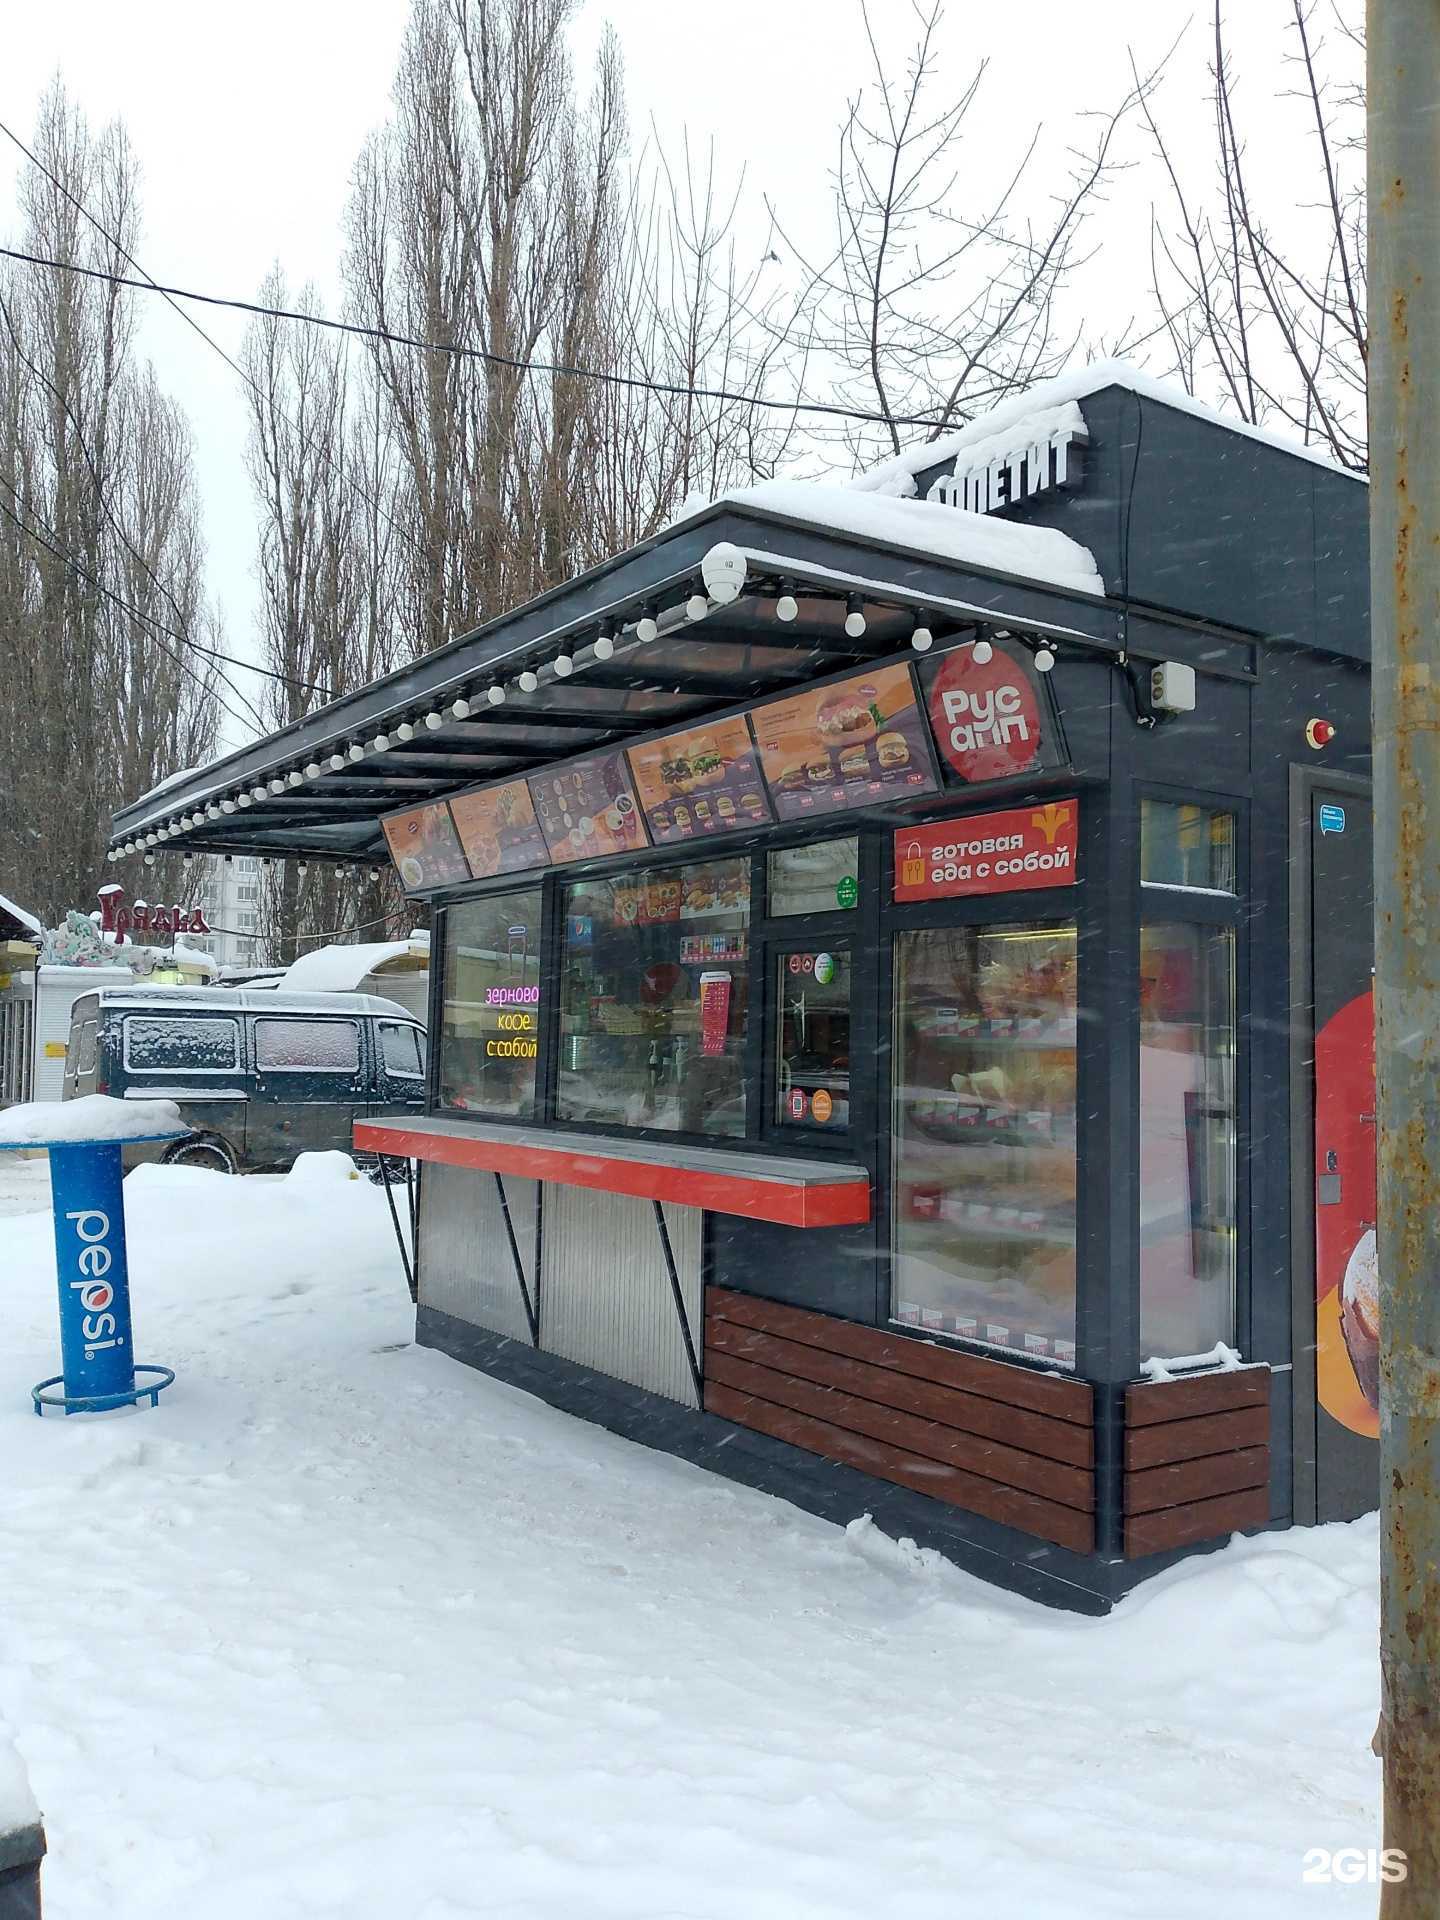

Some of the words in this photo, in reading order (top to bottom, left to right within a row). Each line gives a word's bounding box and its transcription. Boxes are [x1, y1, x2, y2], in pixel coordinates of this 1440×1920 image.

[942, 685, 1022, 733] Рус
[930, 834, 1024, 862] готовая
[930, 863, 972, 884] еда
[976, 862, 991, 878] с
[994, 846, 1070, 876] собой
[497, 1036, 537, 1057] собой
